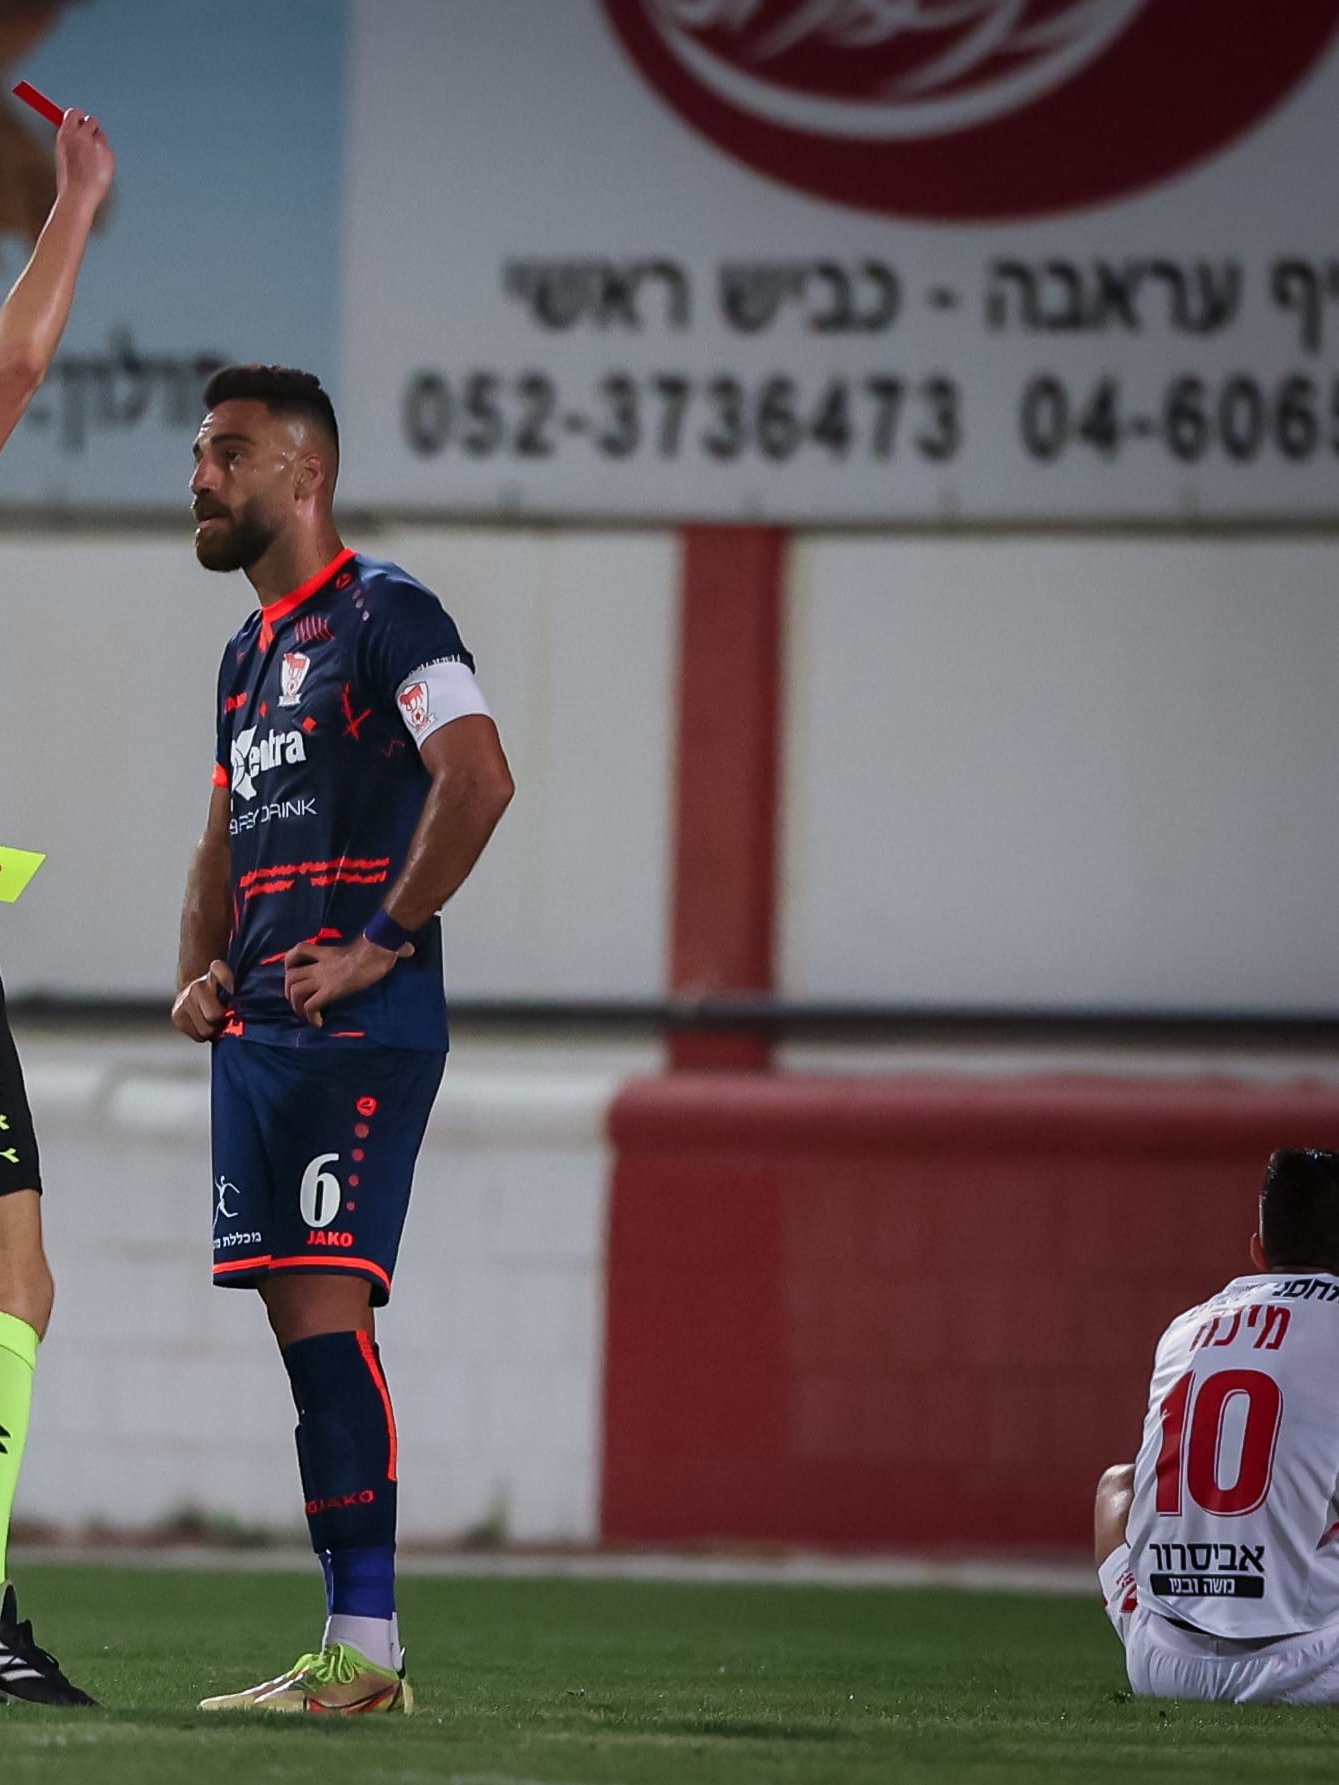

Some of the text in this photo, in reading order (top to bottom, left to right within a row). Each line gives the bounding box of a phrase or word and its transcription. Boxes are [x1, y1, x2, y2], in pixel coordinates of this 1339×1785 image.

[402, 370, 1339, 465] 052-3736473 04-606
[299, 1152, 342, 1229] 6
[307, 1230, 354, 1248] JAKO
[1155, 1368, 1284, 1518] 10
[1203, 1577, 1236, 1594] משה
